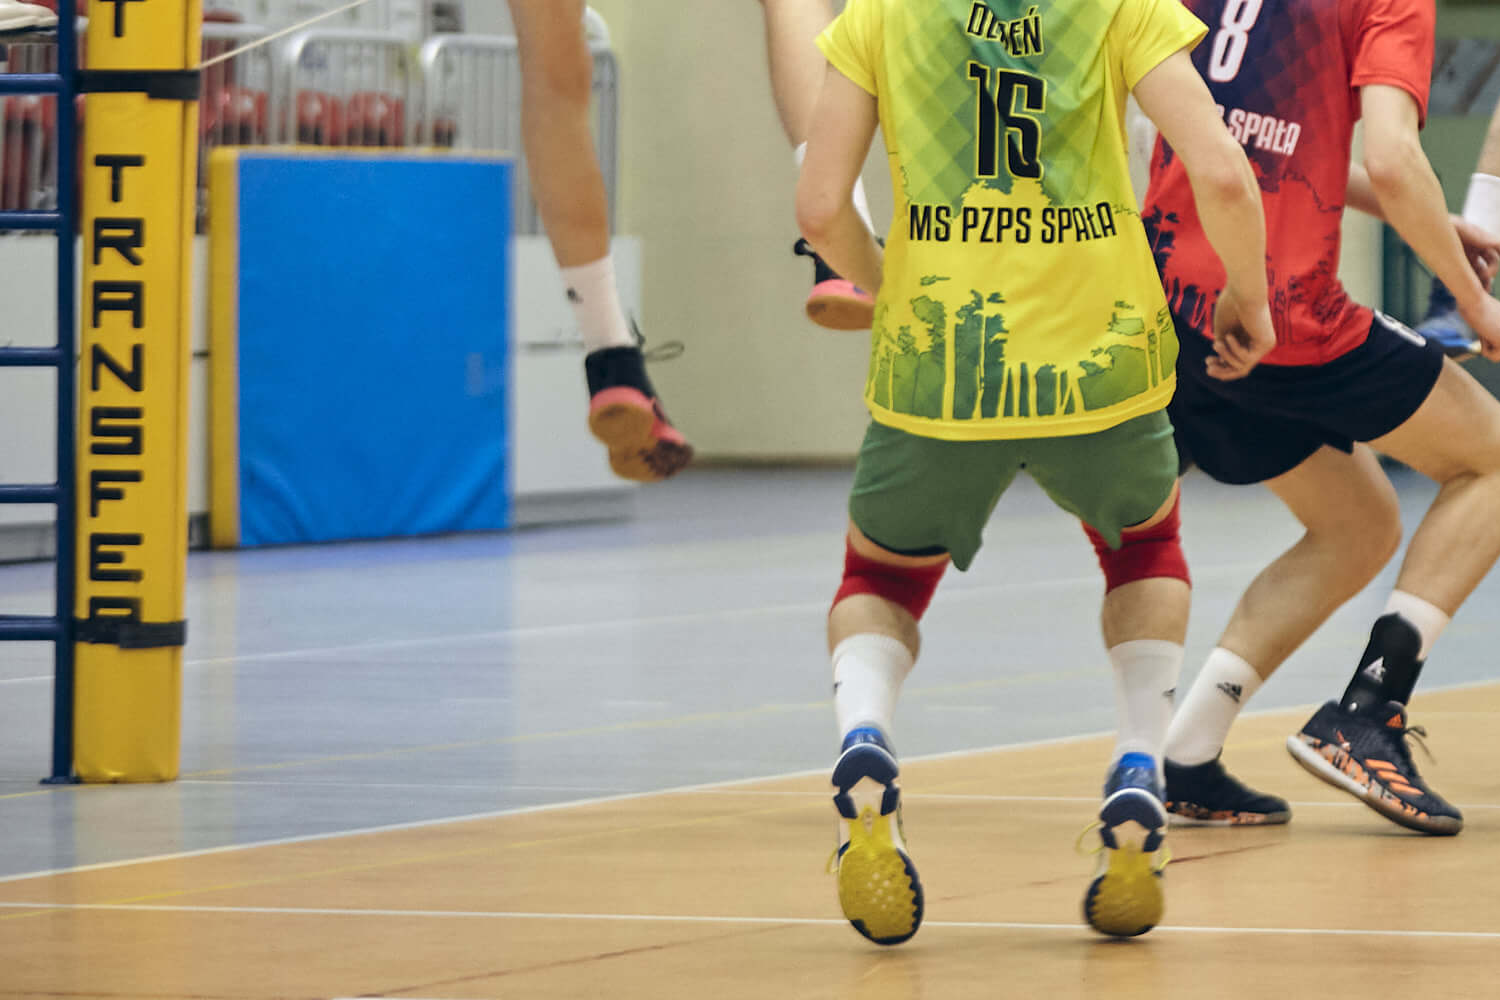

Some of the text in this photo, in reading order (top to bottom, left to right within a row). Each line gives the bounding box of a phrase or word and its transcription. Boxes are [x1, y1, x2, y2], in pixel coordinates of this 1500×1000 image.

[1227, 108, 1302, 156] SPAŁA
[961, 206, 1032, 244] PZPS
[1041, 201, 1118, 245] SPAŁA
